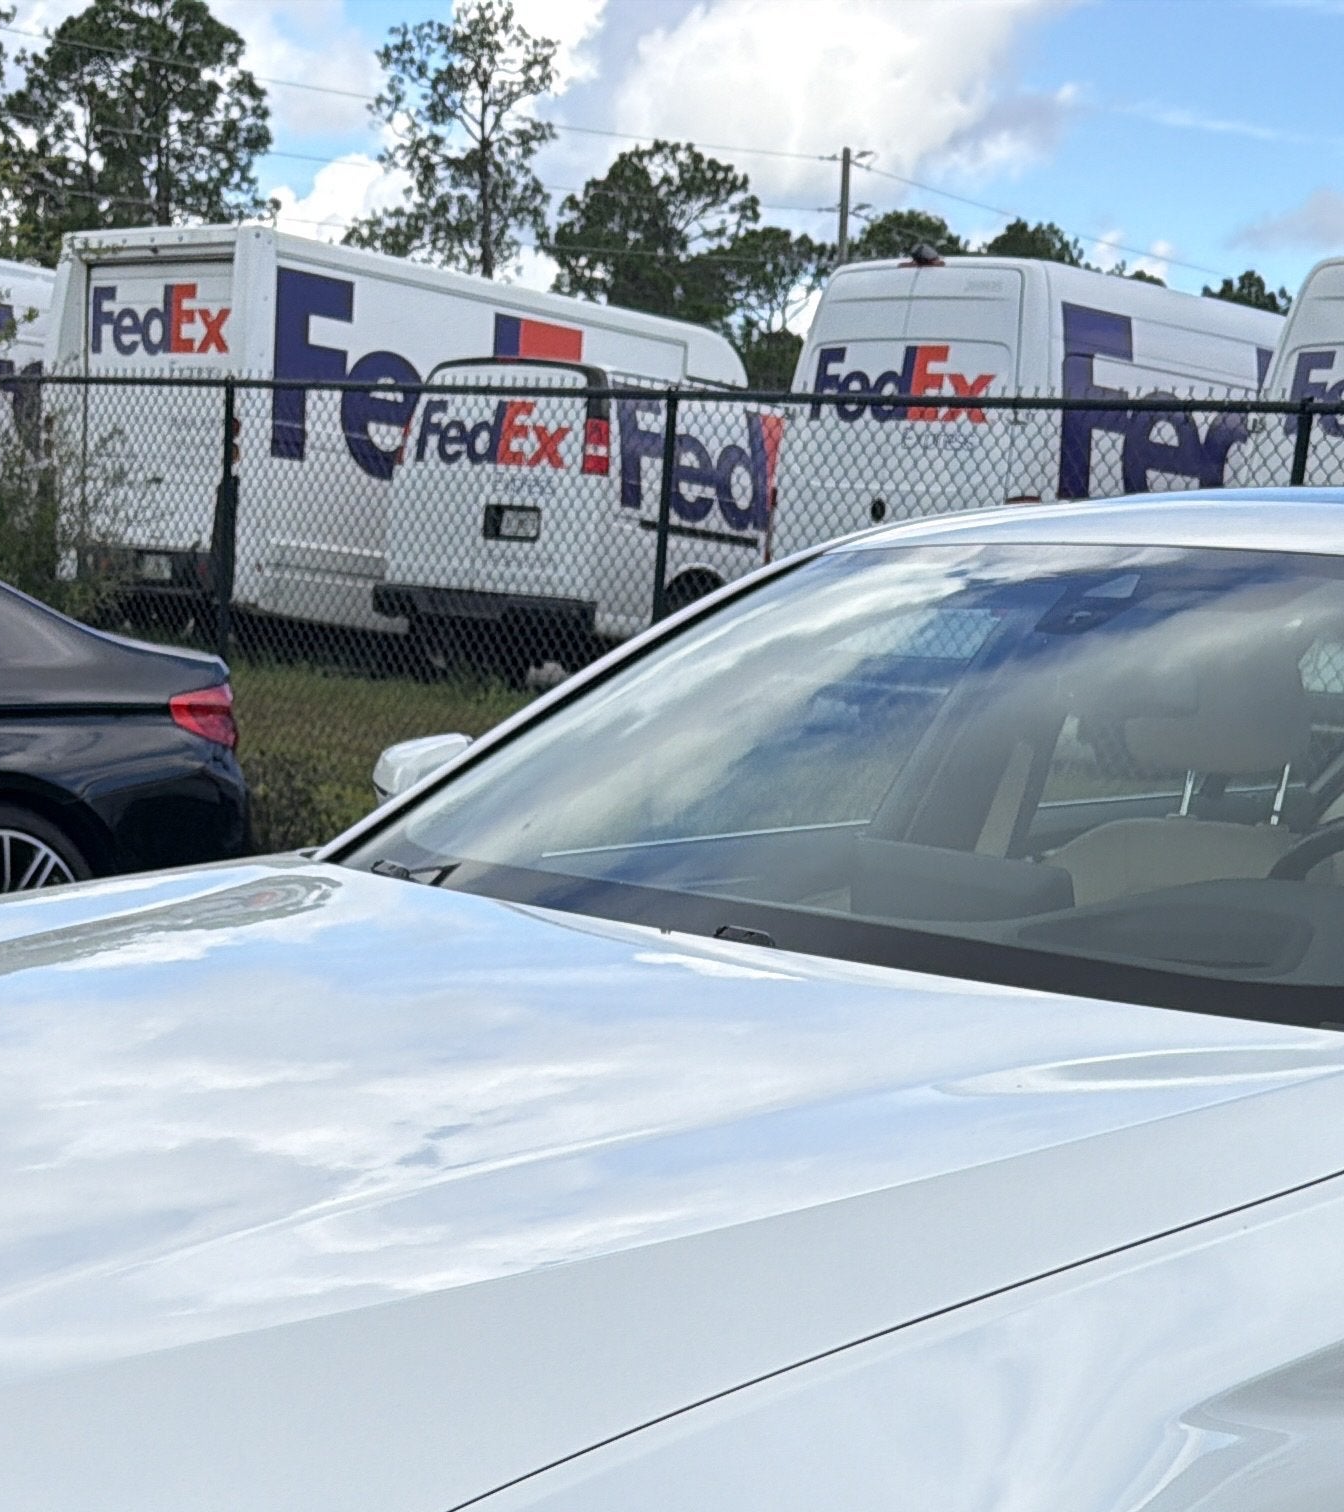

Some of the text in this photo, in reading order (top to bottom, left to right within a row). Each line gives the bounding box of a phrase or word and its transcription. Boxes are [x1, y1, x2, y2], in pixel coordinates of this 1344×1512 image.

[92, 283, 231, 355] FedEx
[809, 345, 997, 424] FedEx
[415, 399, 572, 469] FedEx
